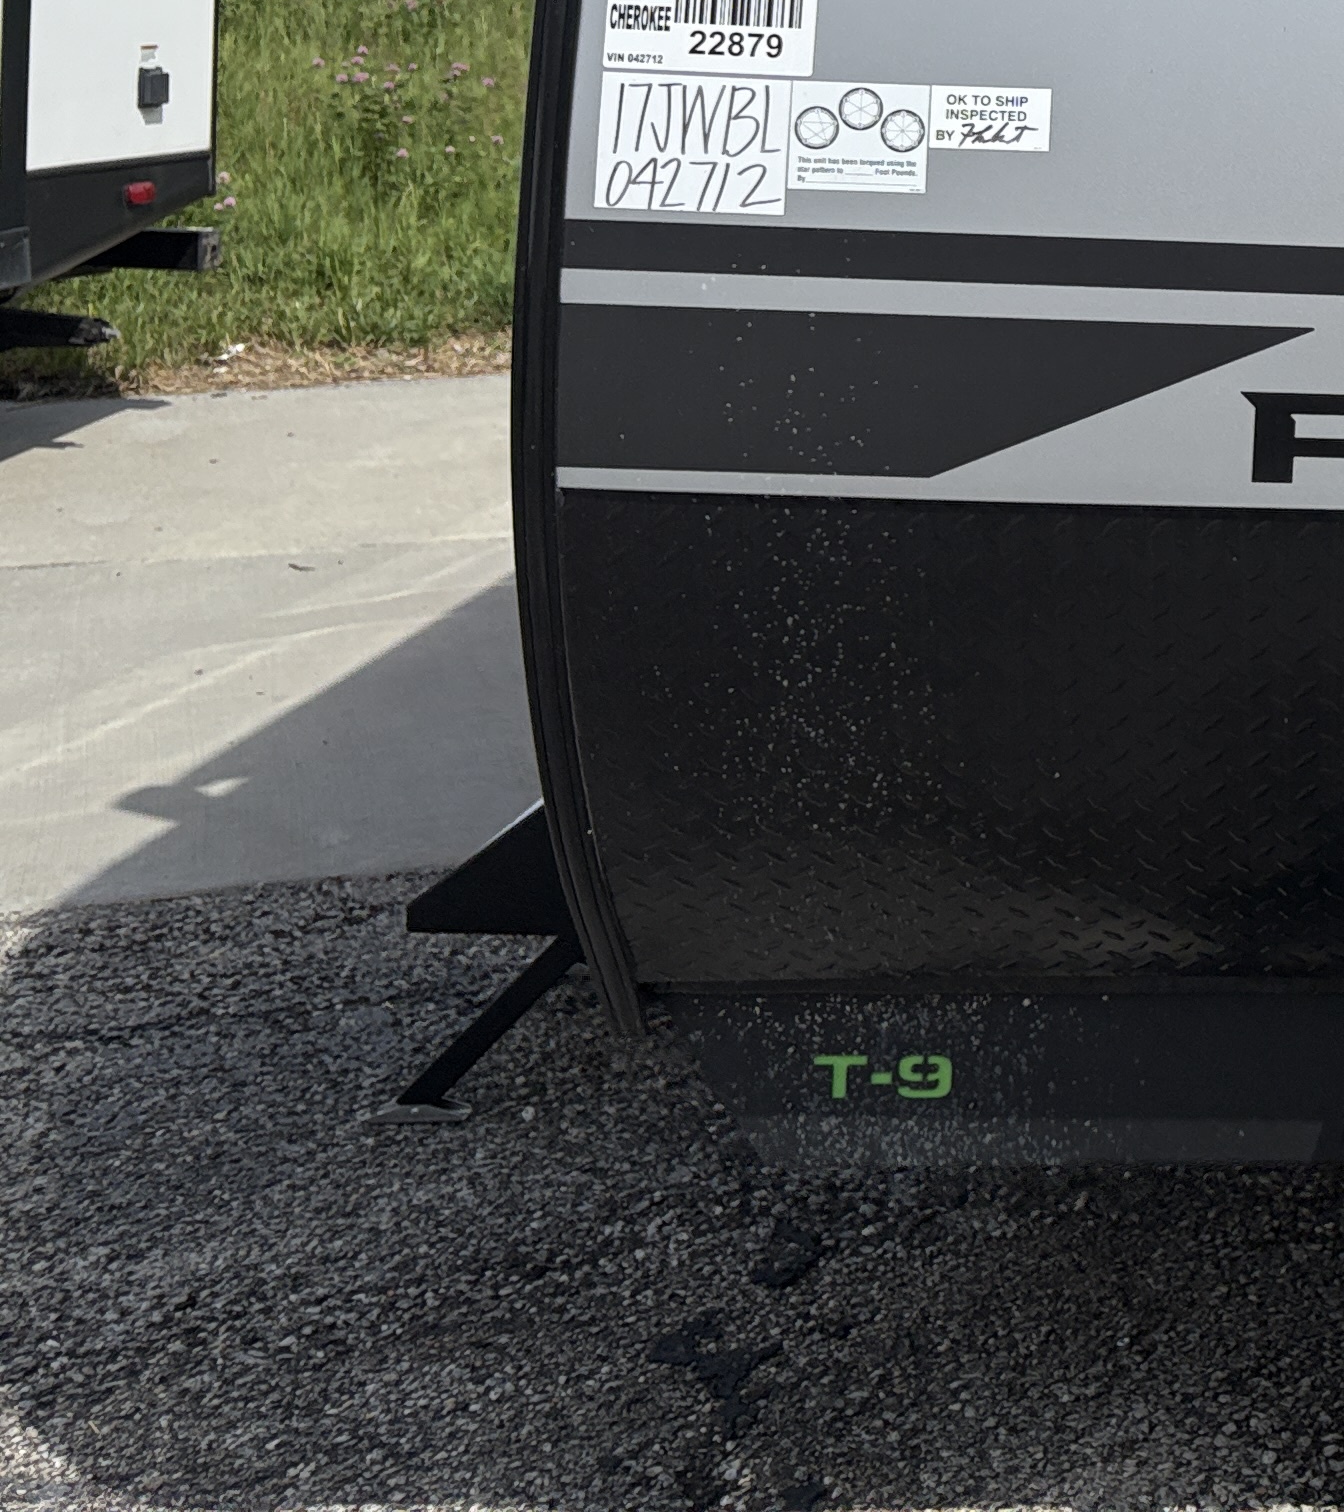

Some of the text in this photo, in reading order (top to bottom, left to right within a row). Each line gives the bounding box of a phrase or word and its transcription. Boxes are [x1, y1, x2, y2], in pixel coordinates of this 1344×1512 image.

[610, 3, 672, 32] CHEROKEE
[606, 52, 664, 65] VIN 042712
[688, 30, 783, 59] 22879
[945, 108, 1027, 122] INSPECTED
[946, 94, 1029, 108] OK TO SHIP
[612, 82, 782, 158] 17JWBL
[935, 129, 955, 142] BY
[605, 157, 783, 212] 042712
[813, 1053, 954, 1100] T-9
